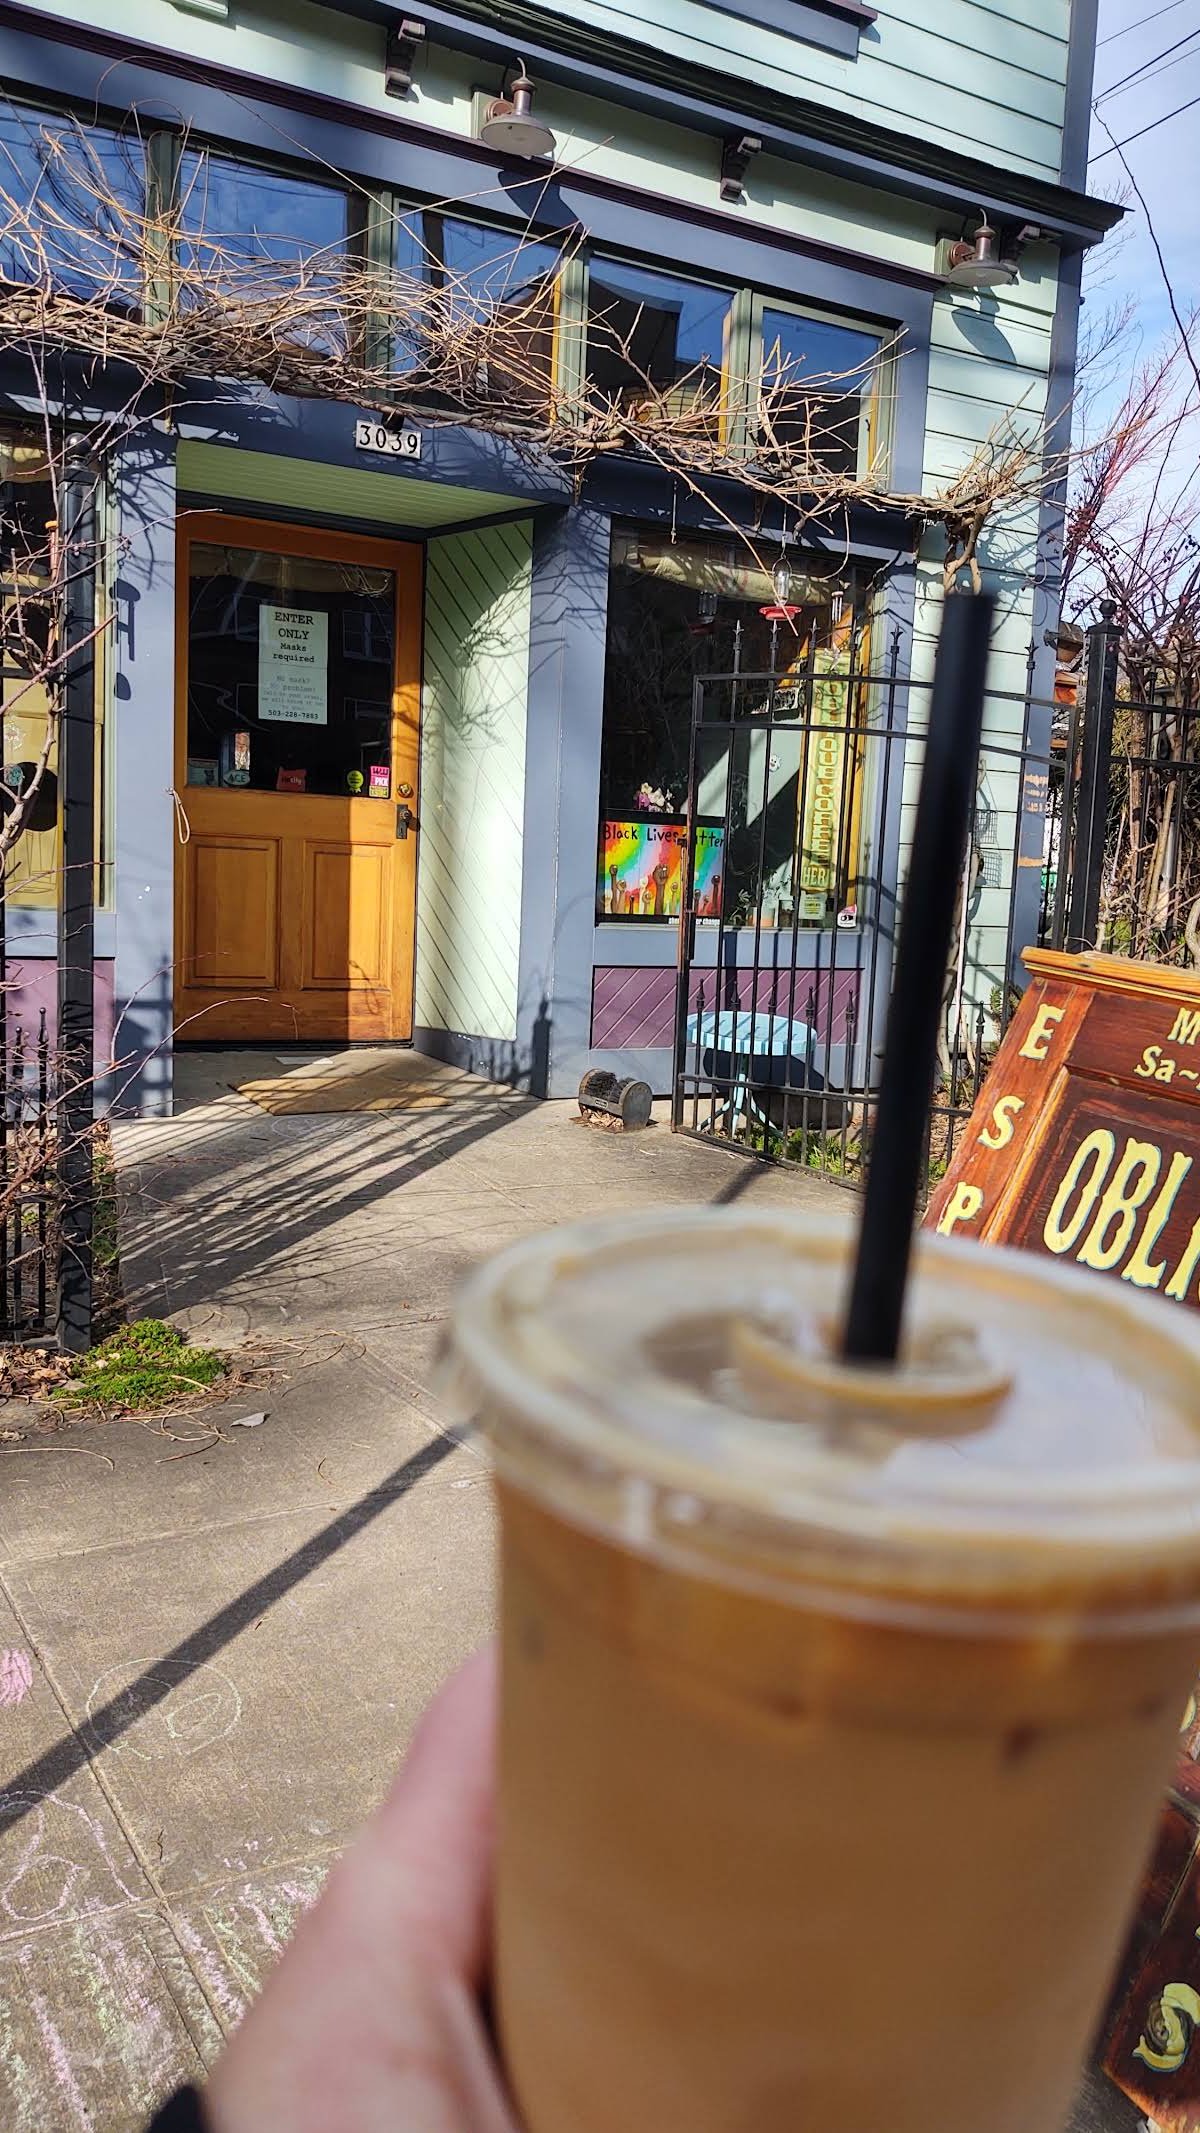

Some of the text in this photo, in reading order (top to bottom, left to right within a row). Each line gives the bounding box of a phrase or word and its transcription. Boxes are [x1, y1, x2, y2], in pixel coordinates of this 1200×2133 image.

[359, 424, 418, 454] 3039
[274, 611, 315, 626] ENTER
[278, 627, 310, 640] ONLY
[280, 642, 307, 652] Masks
[272, 653, 315, 663] required
[227, 773, 247, 784] ACE
[603, 823, 638, 841] Black
[646, 827, 679, 843] Lives
